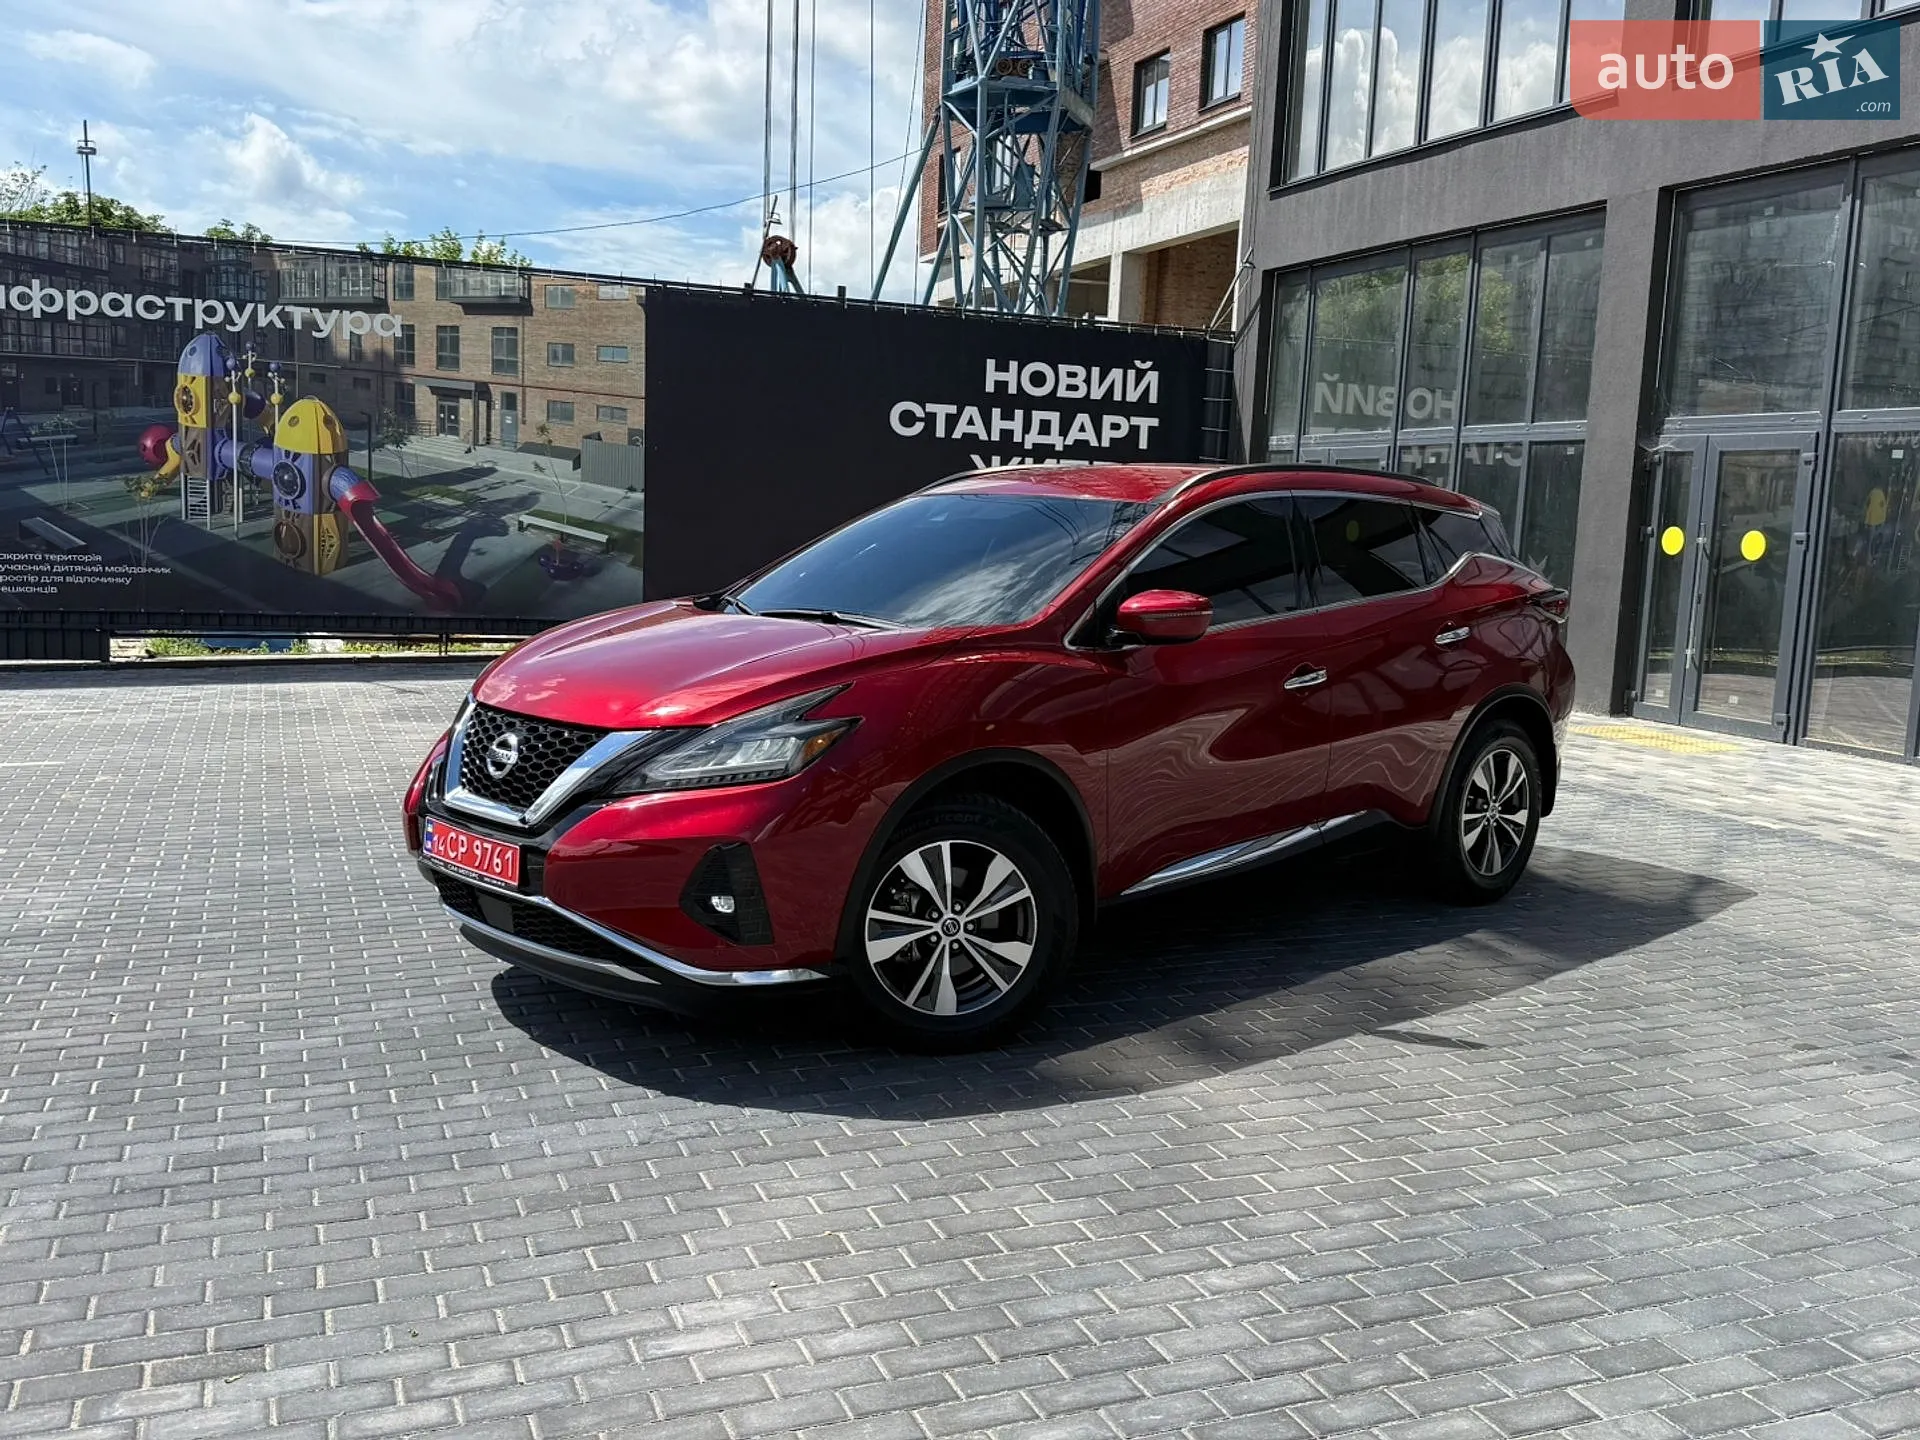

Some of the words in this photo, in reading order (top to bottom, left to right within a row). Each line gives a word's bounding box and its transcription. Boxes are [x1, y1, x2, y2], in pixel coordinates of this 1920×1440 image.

[0, 278, 403, 339] фраструктура
[985, 358, 1159, 404] НОВИЙ
[889, 401, 1160, 451] СТАНДАРТ
[45, 553, 103, 563] територія
[53, 563, 103, 573] дитячий
[41, 575, 64, 584] для
[473, 839, 514, 878] 9761
